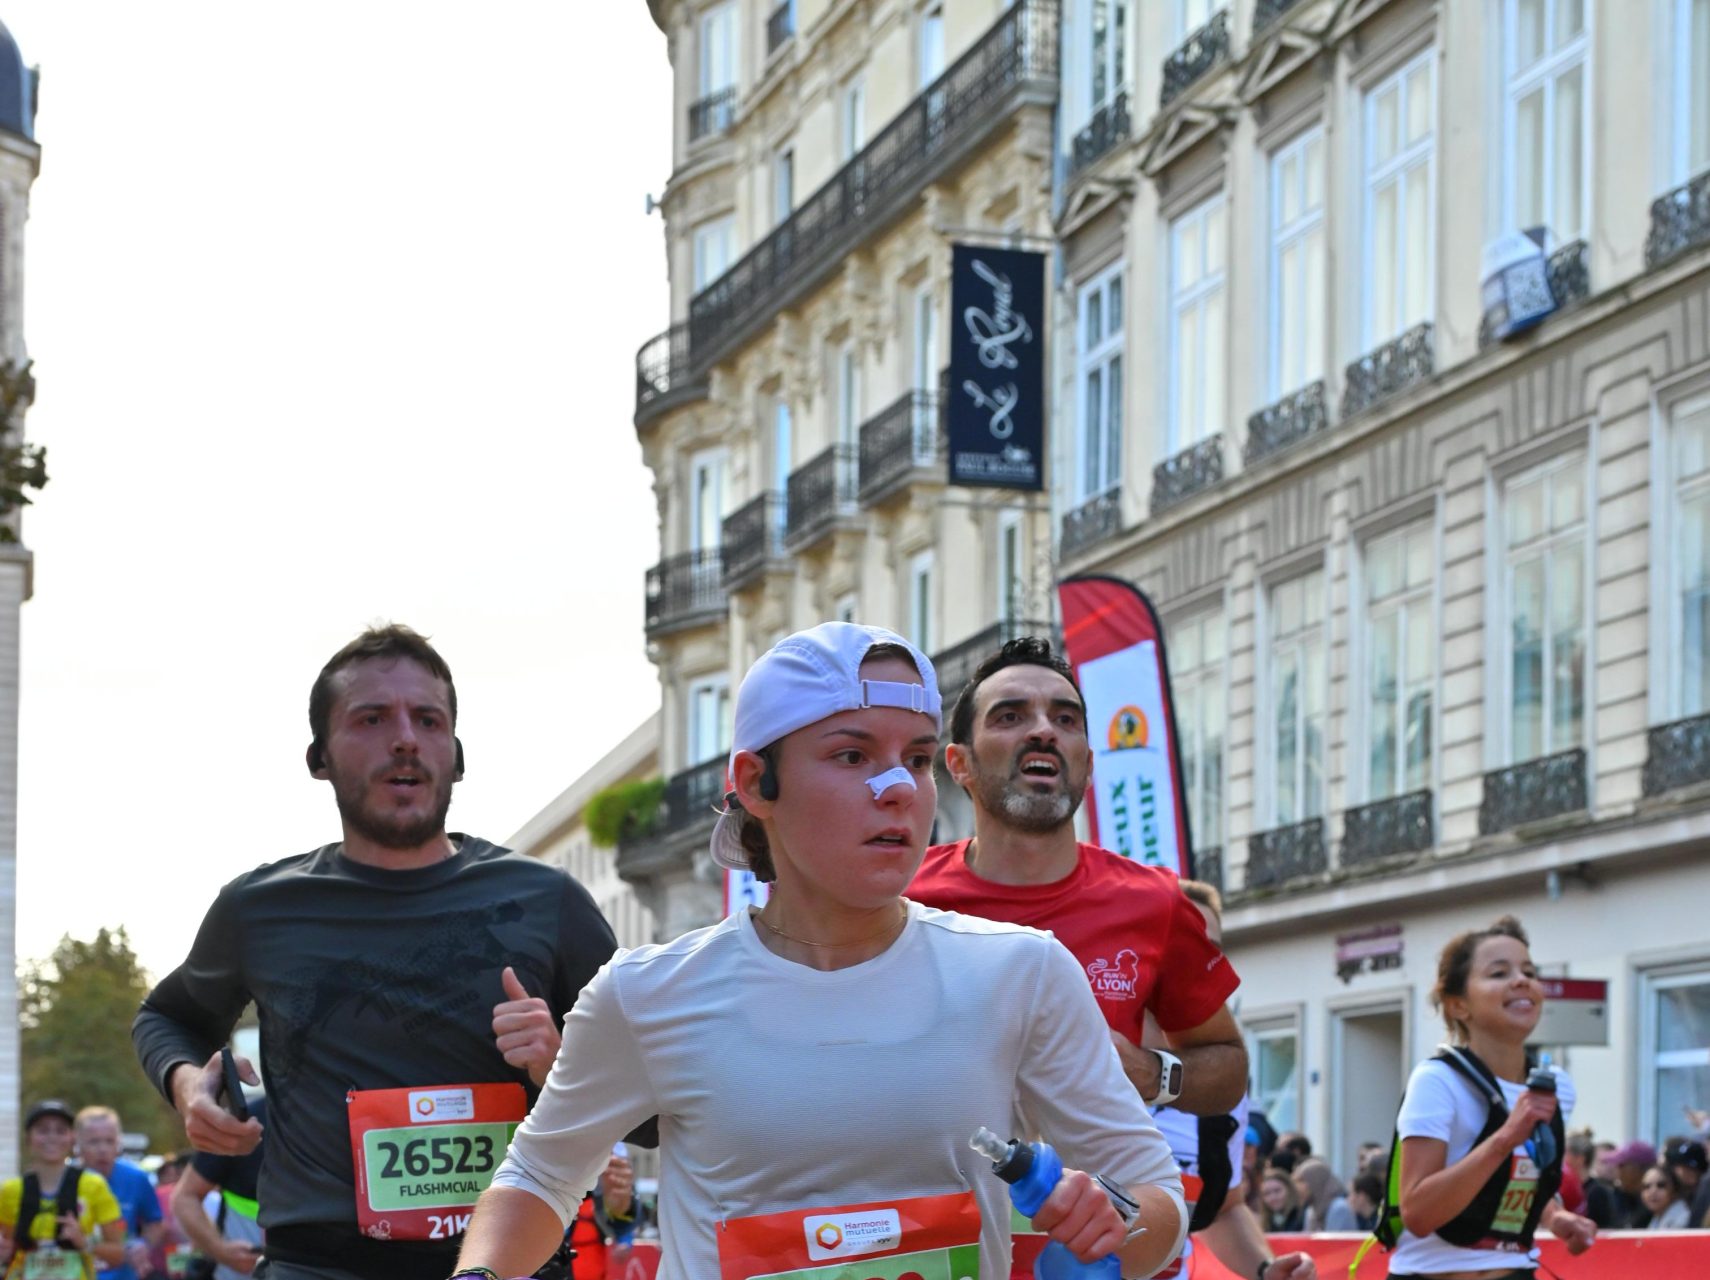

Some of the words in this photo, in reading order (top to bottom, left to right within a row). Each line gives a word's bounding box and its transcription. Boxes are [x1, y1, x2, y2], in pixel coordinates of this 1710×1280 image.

[961, 379, 1019, 439] Le
[1097, 978, 1131, 991] LYON
[376, 1135, 494, 1179] 26523
[399, 1180, 481, 1197] FLASHMCVAL
[427, 1213, 473, 1239] 21K
[844, 1220, 890, 1230] Harmonie
[846, 1226, 891, 1236] mutuelle
